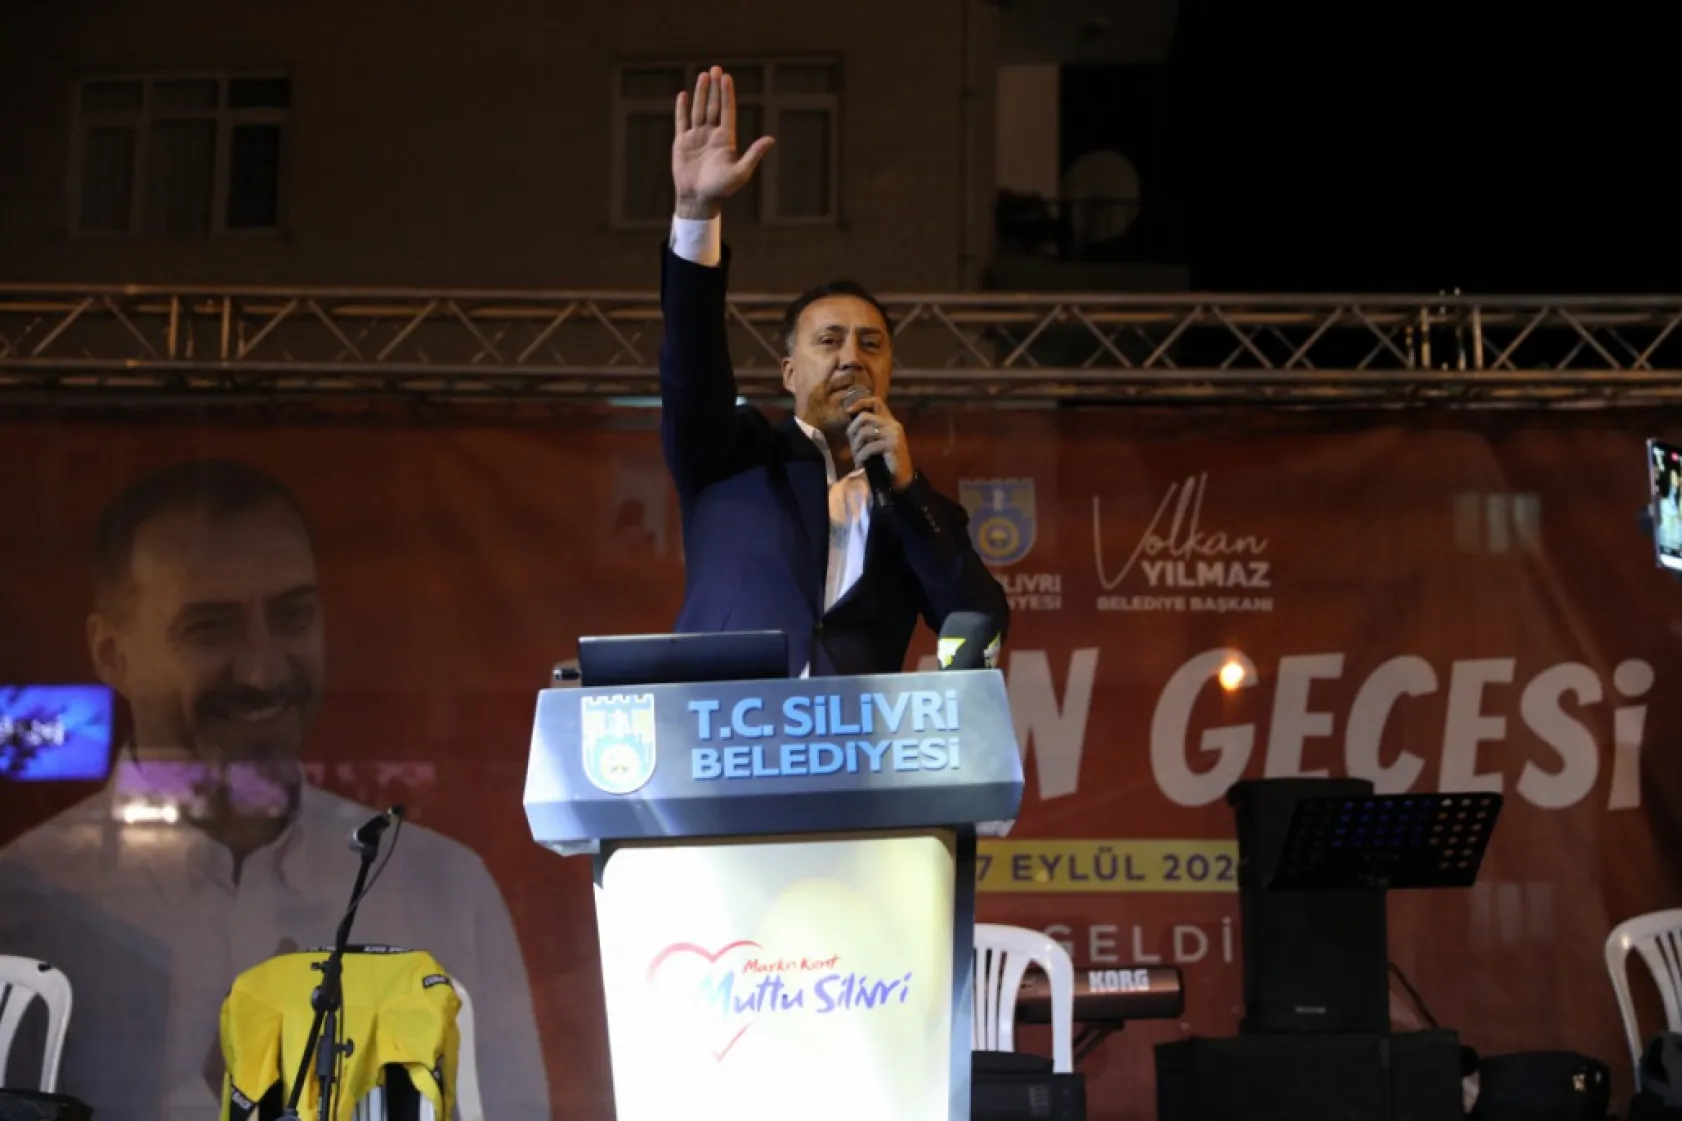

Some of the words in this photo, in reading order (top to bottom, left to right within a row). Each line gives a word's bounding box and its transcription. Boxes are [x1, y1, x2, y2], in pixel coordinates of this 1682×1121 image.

[1092, 471, 1269, 590] Volkan
[1142, 560, 1271, 589] YILMAZ
[688, 700, 773, 740] T.C.
[1013, 847, 1146, 881] EYLÜL
[1089, 969, 1150, 992] KORG
